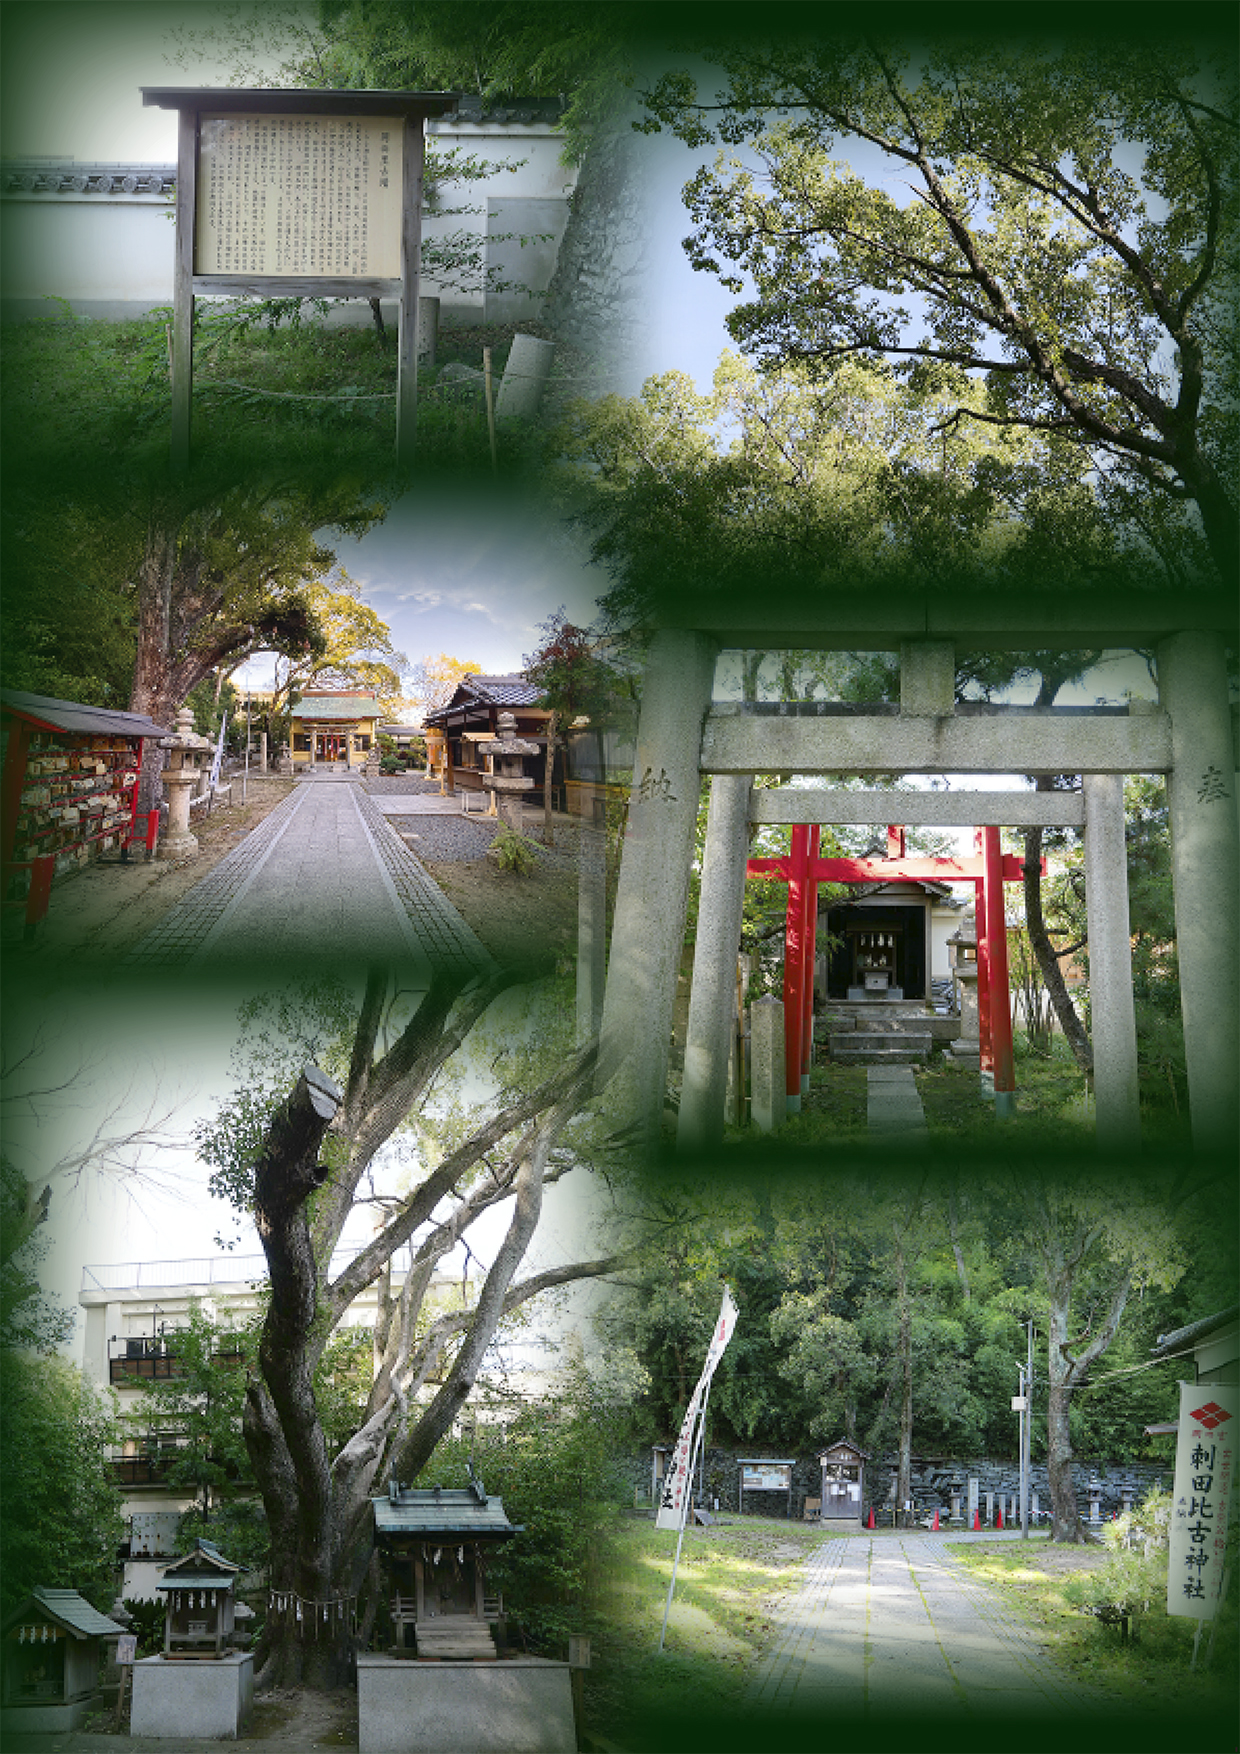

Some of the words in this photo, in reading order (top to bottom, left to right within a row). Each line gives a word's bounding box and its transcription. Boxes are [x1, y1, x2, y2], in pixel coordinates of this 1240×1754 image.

[1197, 766, 1231, 805] 奉
[1182, 1442, 1216, 1600] 刺田比古神社
